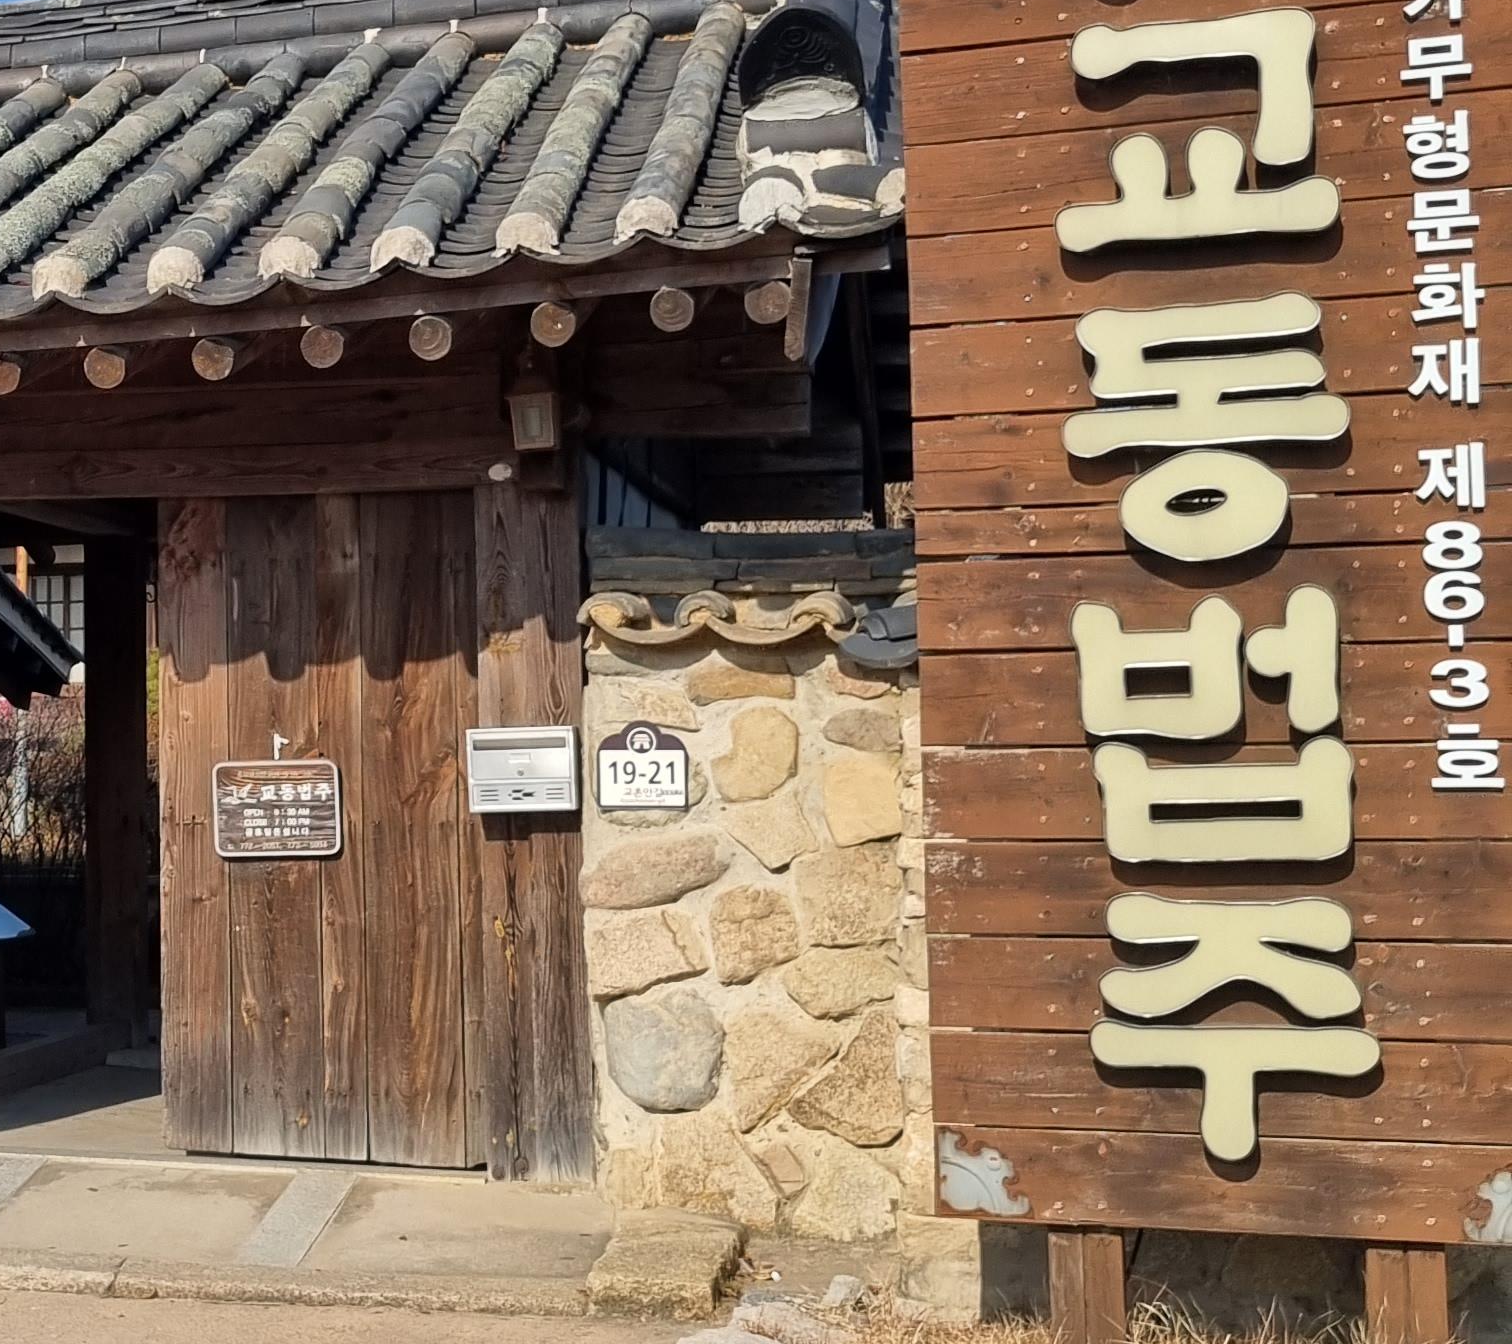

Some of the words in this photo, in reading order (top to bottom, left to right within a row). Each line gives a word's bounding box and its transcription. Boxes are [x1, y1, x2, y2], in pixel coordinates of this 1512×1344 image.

[1053, 7, 1381, 1163] 교동법주
[1415, 442, 1505, 792] 제86-3호
[260, 782, 332, 802] 교동법주
[608, 760, 675, 785] 19-21
